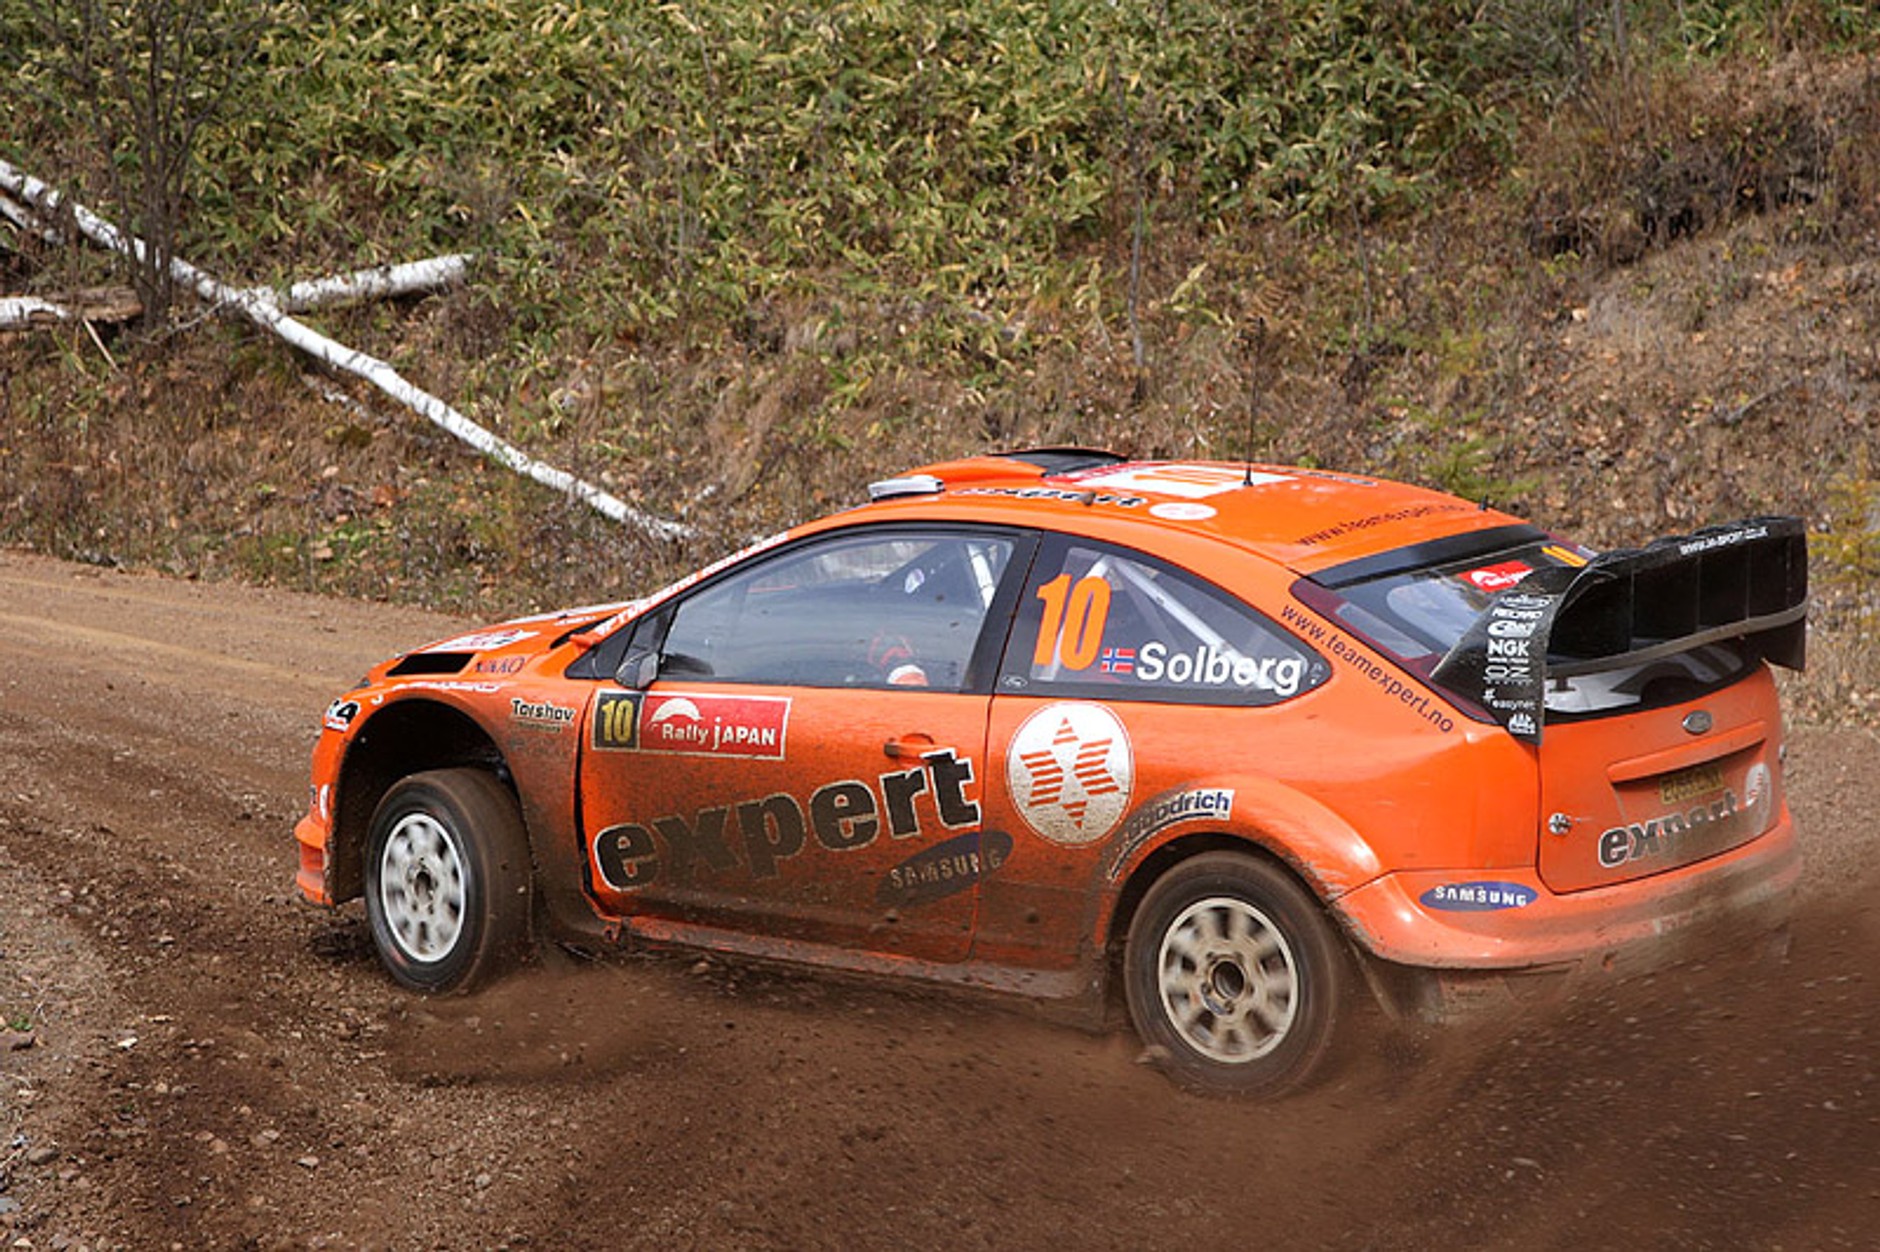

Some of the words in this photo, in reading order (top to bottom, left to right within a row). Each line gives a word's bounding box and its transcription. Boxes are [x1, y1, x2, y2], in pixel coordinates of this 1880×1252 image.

[1033, 573, 1110, 670] 10
[1137, 642, 1301, 695] Solberg
[1280, 604, 1454, 733] www.teamexpert.no
[1487, 639, 1531, 657] NGK
[601, 700, 634, 744] 10
[661, 723, 709, 745] Rally
[594, 748, 982, 892] expert
[889, 847, 1002, 890] SAMSUNG
[1434, 885, 1528, 908] SAMSUNG
